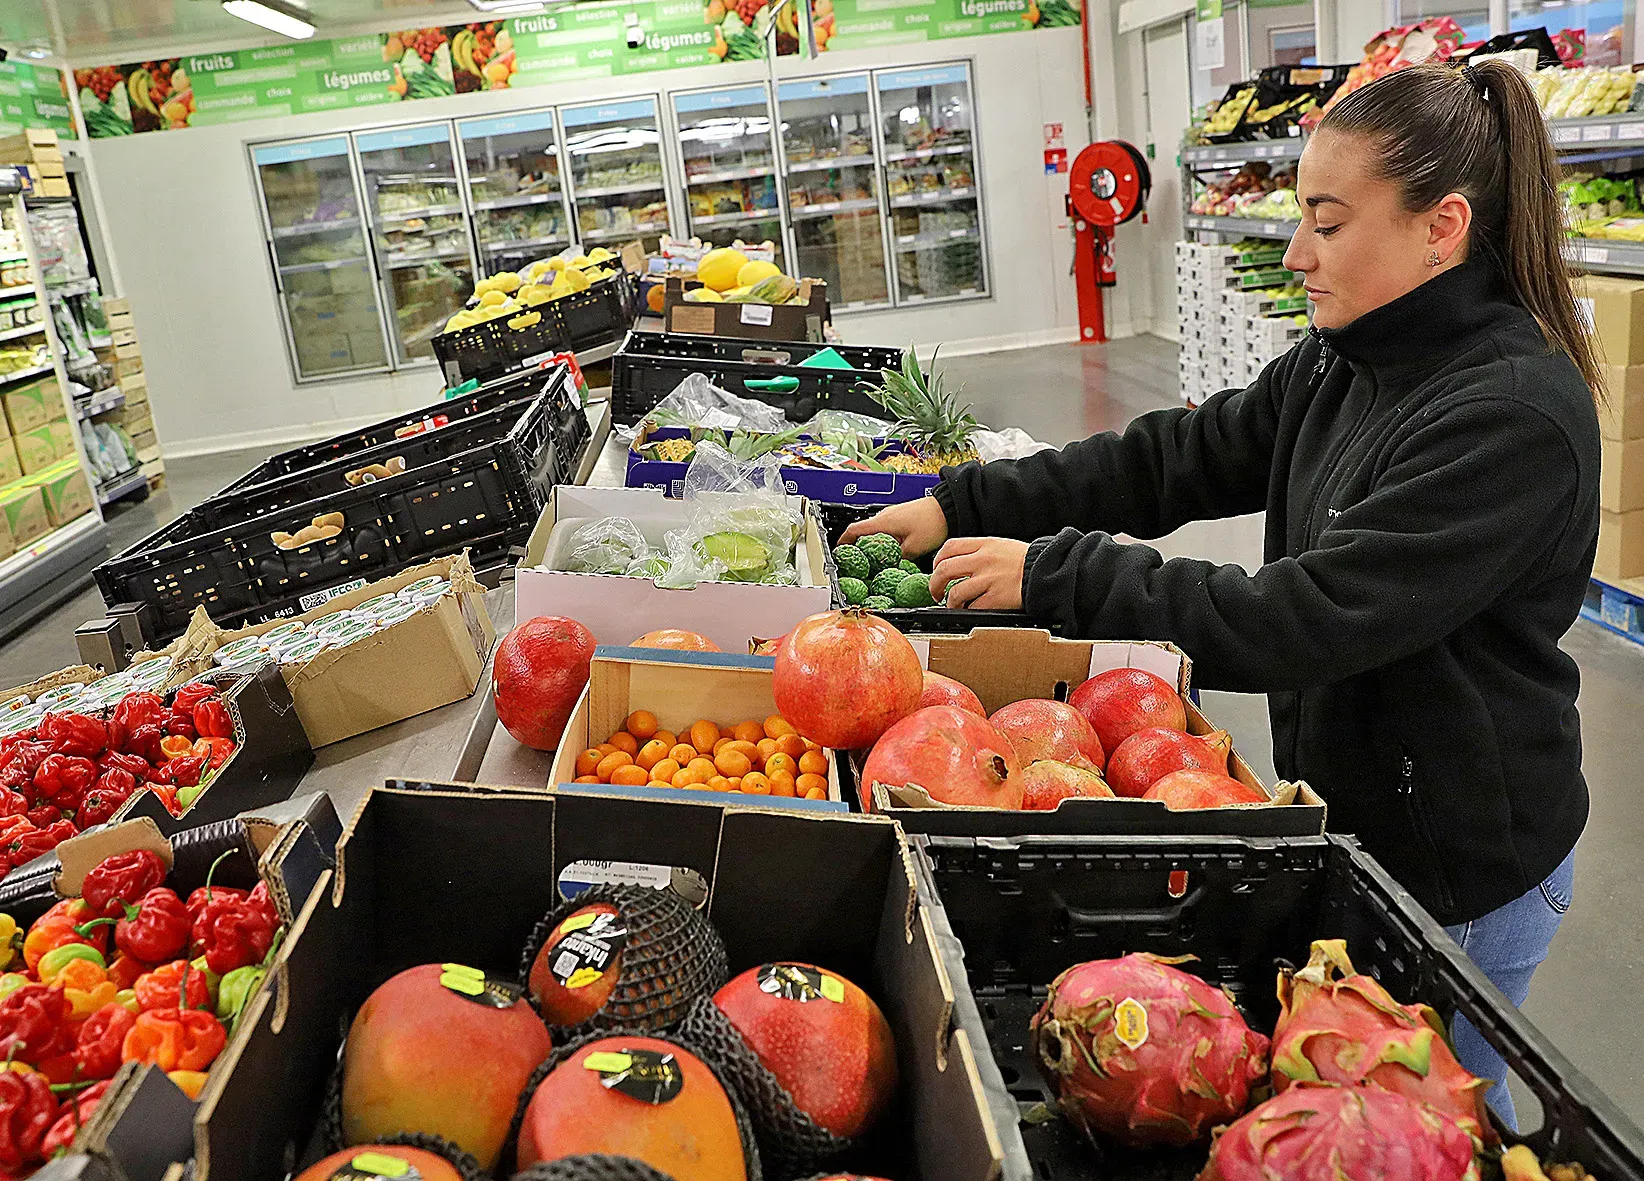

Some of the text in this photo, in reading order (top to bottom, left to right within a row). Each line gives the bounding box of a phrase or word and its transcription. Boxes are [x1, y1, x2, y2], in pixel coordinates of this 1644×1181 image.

[514, 16, 557, 34] fruits
[645, 32, 712, 52] légumes
[190, 54, 234, 73] fruits
[324, 70, 391, 90] légumes
[329, 584, 352, 597] IFCO
[275, 606, 294, 618] 6413
